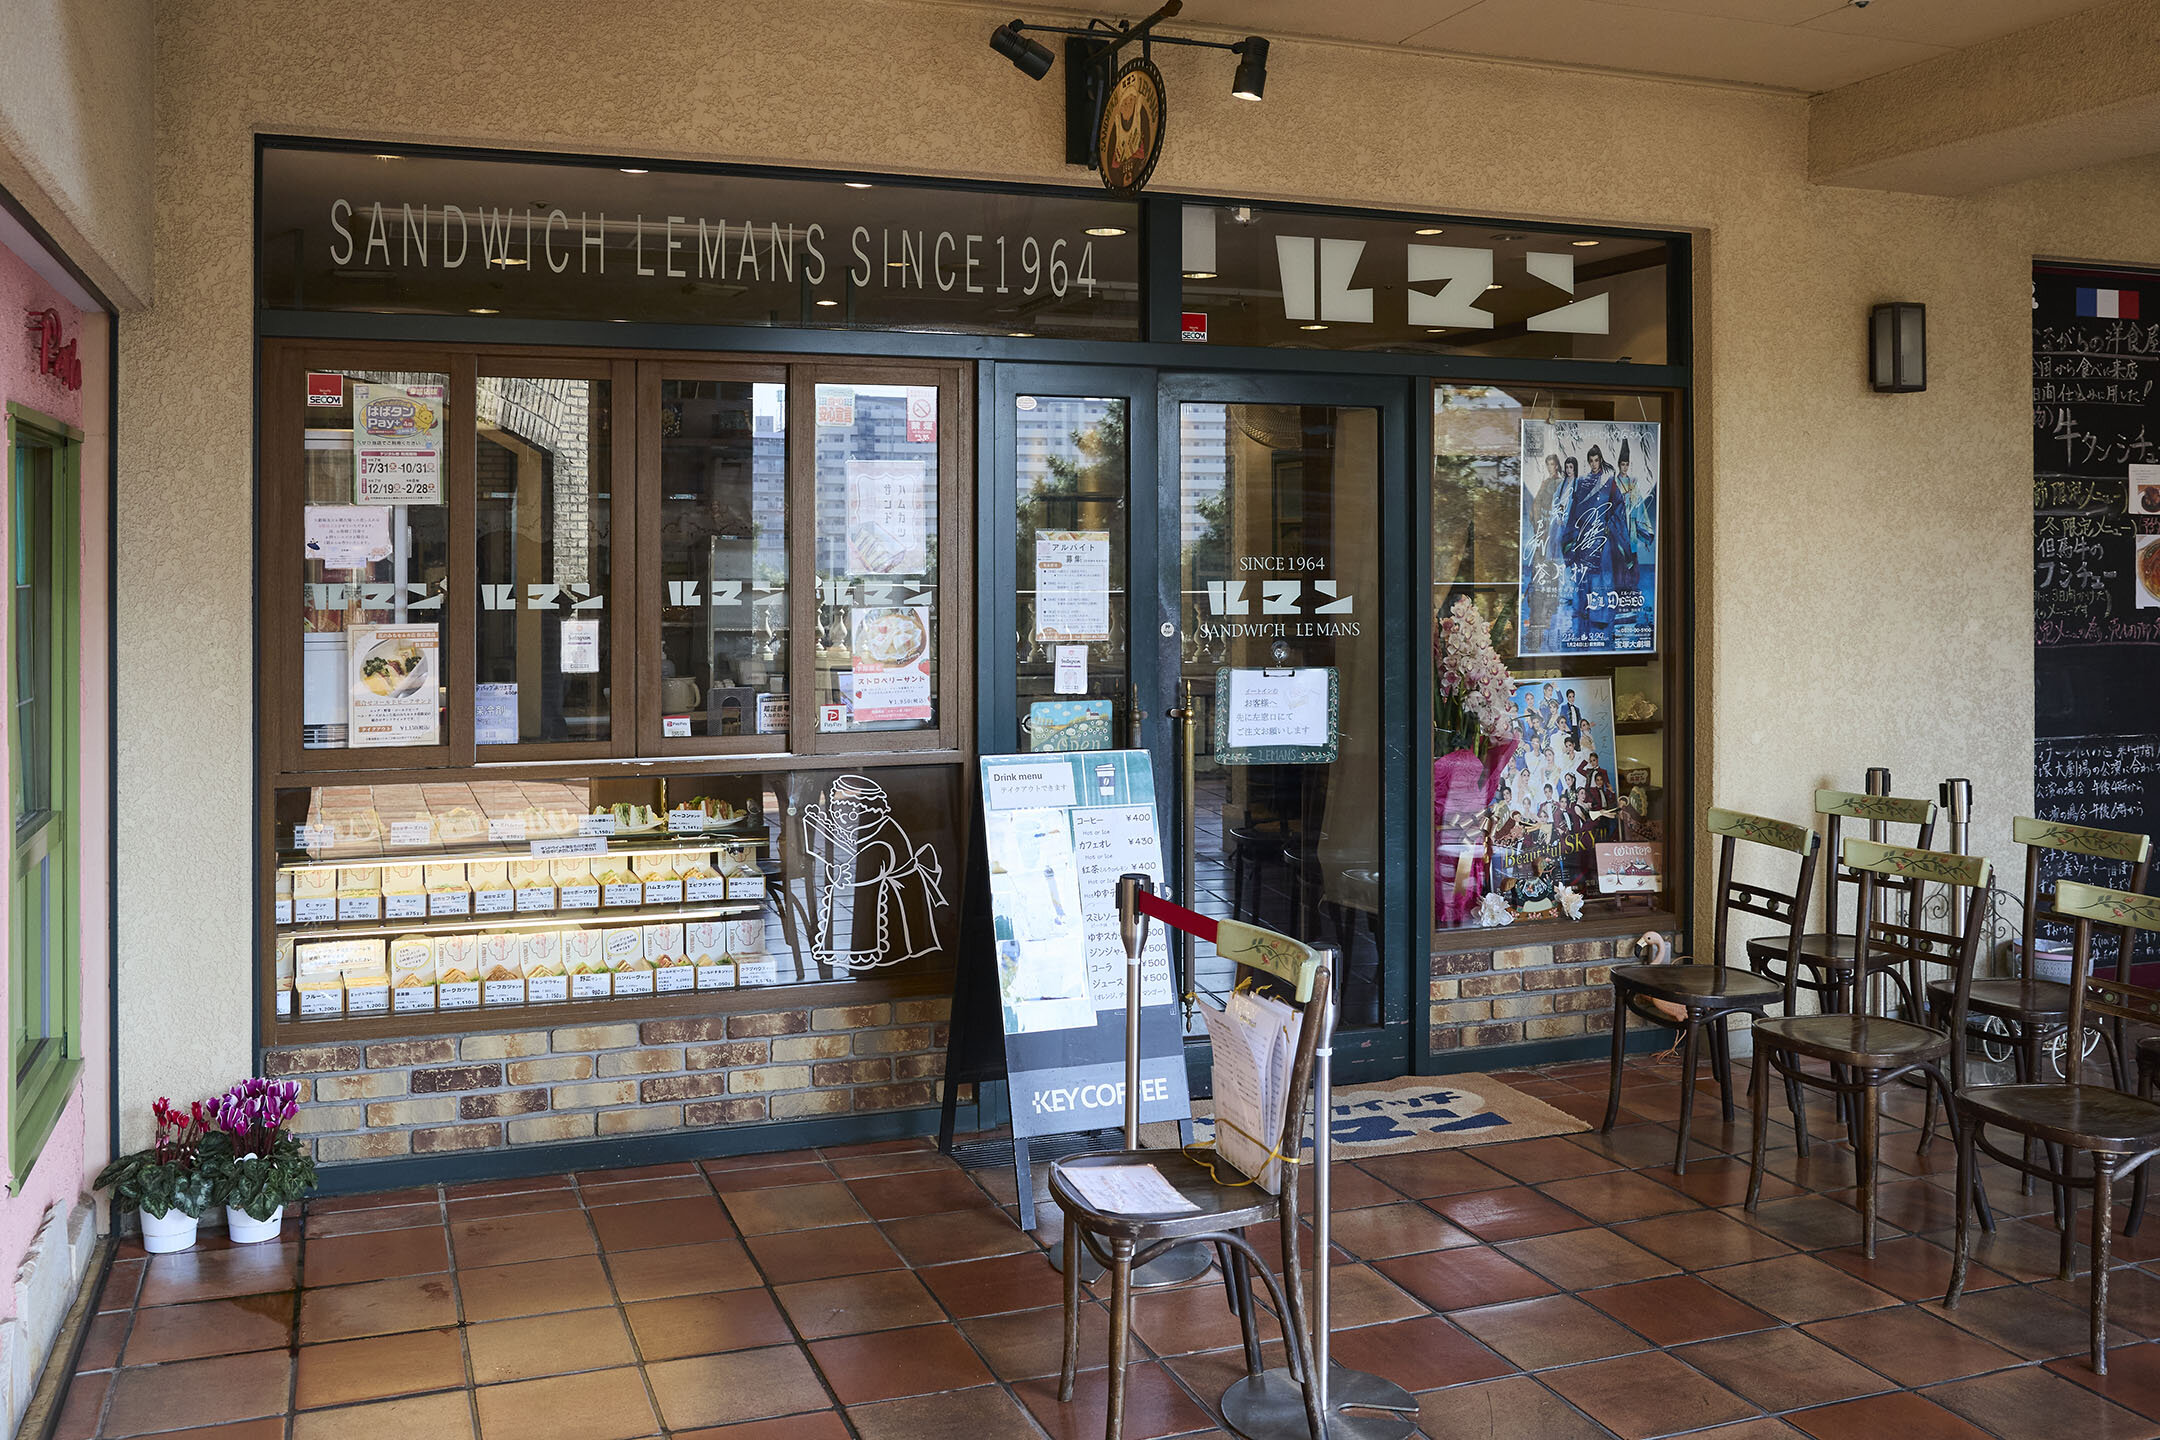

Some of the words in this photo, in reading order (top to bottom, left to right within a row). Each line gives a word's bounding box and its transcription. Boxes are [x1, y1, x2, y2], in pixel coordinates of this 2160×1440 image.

[331, 198, 603, 274] SANDWICH
[636, 216, 826, 286] LEMANS
[1275, 234, 1610, 335] ルマン
[1181, 331, 1207, 341] SECOM
[309, 395, 341, 404] SECOM
[367, 406, 415, 417] はばタン
[2053, 407, 2160, 468] 牛タンシチュ
[368, 463, 389, 473] 7/31
[883, 484, 892, 524] サンド
[897, 485, 906, 537] ハムカツ
[1052, 543, 1095, 552] アルバイト
[1239, 556, 1285, 571] SINCE
[1289, 556, 1326, 571] 1964
[1207, 580, 1353, 615] ルマン
[1199, 622, 1285, 639] SANDWICH
[858, 675, 926, 685] ストロベリーサンド
[1244, 698, 1278, 708] お客様へ
[1236, 712, 1293, 722] 先に左窓口にて
[1236, 726, 1310, 736] ご注文お願いします
[993, 773, 1017, 782] Drink
[1018, 772, 1043, 781] menu
[1000, 784, 1067, 793] テイクアウトできます
[1077, 817, 1103, 825] コーヒー
[1126, 813, 1151, 822] ¥400
[1079, 840, 1111, 849] カフェオレ
[1128, 837, 1154, 845] ¥430
[1082, 864, 1099, 874] 紅茶
[1131, 862, 1157, 870] ¥400
[1086, 912, 1118, 922] スミレソー
[1087, 932, 1121, 942] ゆずスカ
[1089, 946, 1126, 958] ジンジャー
[1091, 962, 1113, 973] コーラ
[1141, 958, 1166, 968] ¥500
[1092, 977, 1124, 989] ジュース
[1143, 972, 1168, 982] ¥500
[1080, 1077, 1169, 1110] COFEE
